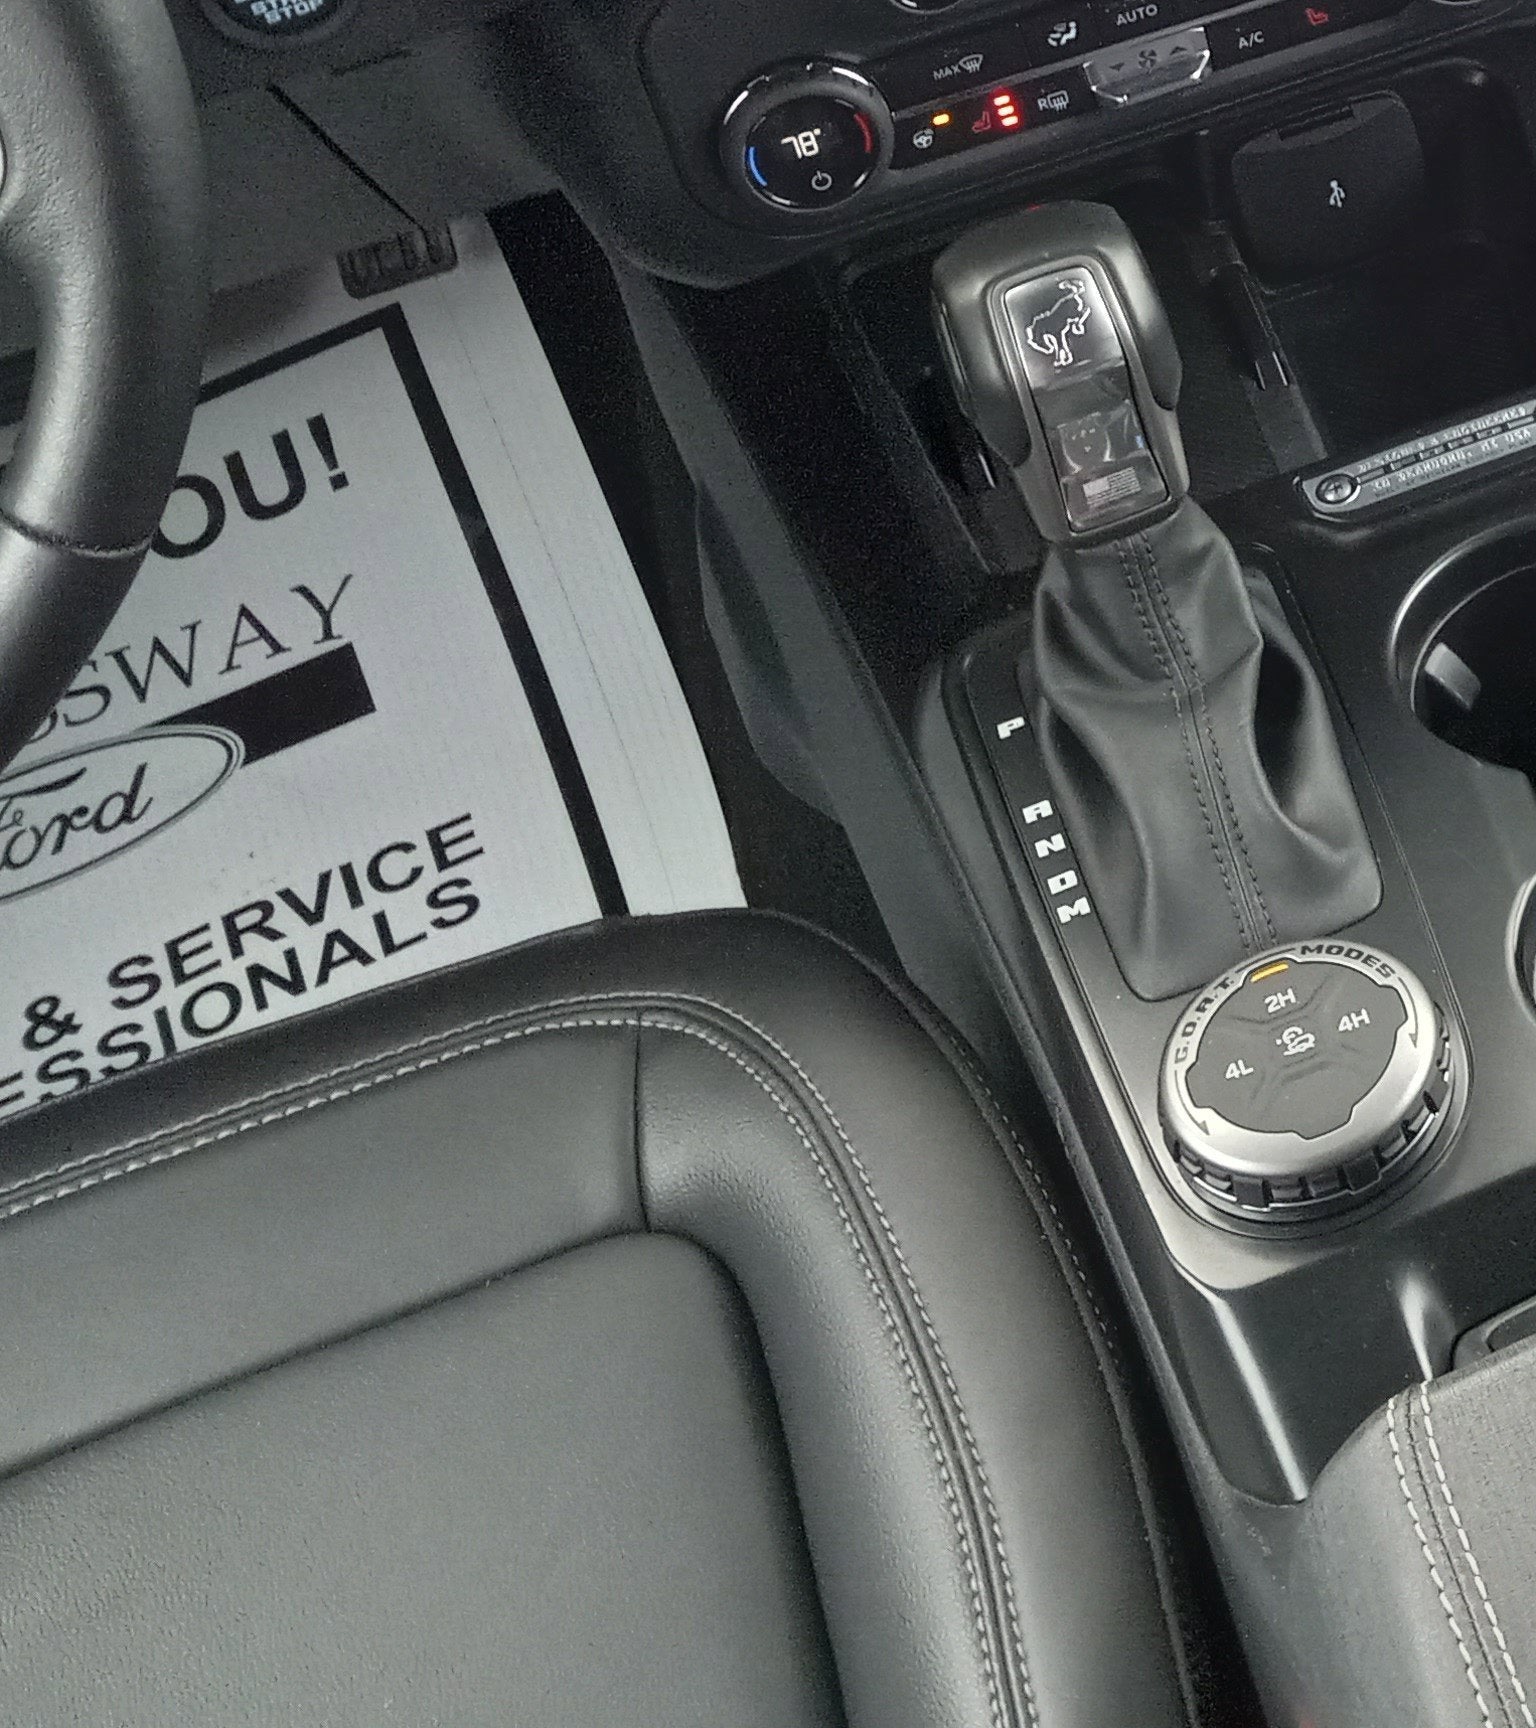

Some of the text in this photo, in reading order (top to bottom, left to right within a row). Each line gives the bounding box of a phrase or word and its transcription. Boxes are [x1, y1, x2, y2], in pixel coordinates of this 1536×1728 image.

[1115, 3, 1159, 27] AUTO
[1237, 29, 1265, 50] A/C
[933, 63, 961, 81] MAX
[780, 128, 822, 160] 78°
[150, 412, 350, 560] OU!
[26, 573, 354, 743] SWAY
[997, 716, 1026, 740] P
[1034, 832, 1067, 858] N
[1047, 869, 1078, 895] D
[1056, 896, 1091, 924] M
[22, 812, 486, 1052] & SERVICE
[1300, 943, 1396, 979] MODES
[1264, 987, 1297, 1014] 2H
[1337, 1007, 1371, 1032] 4H
[1224, 1058, 1255, 1080] 4L
